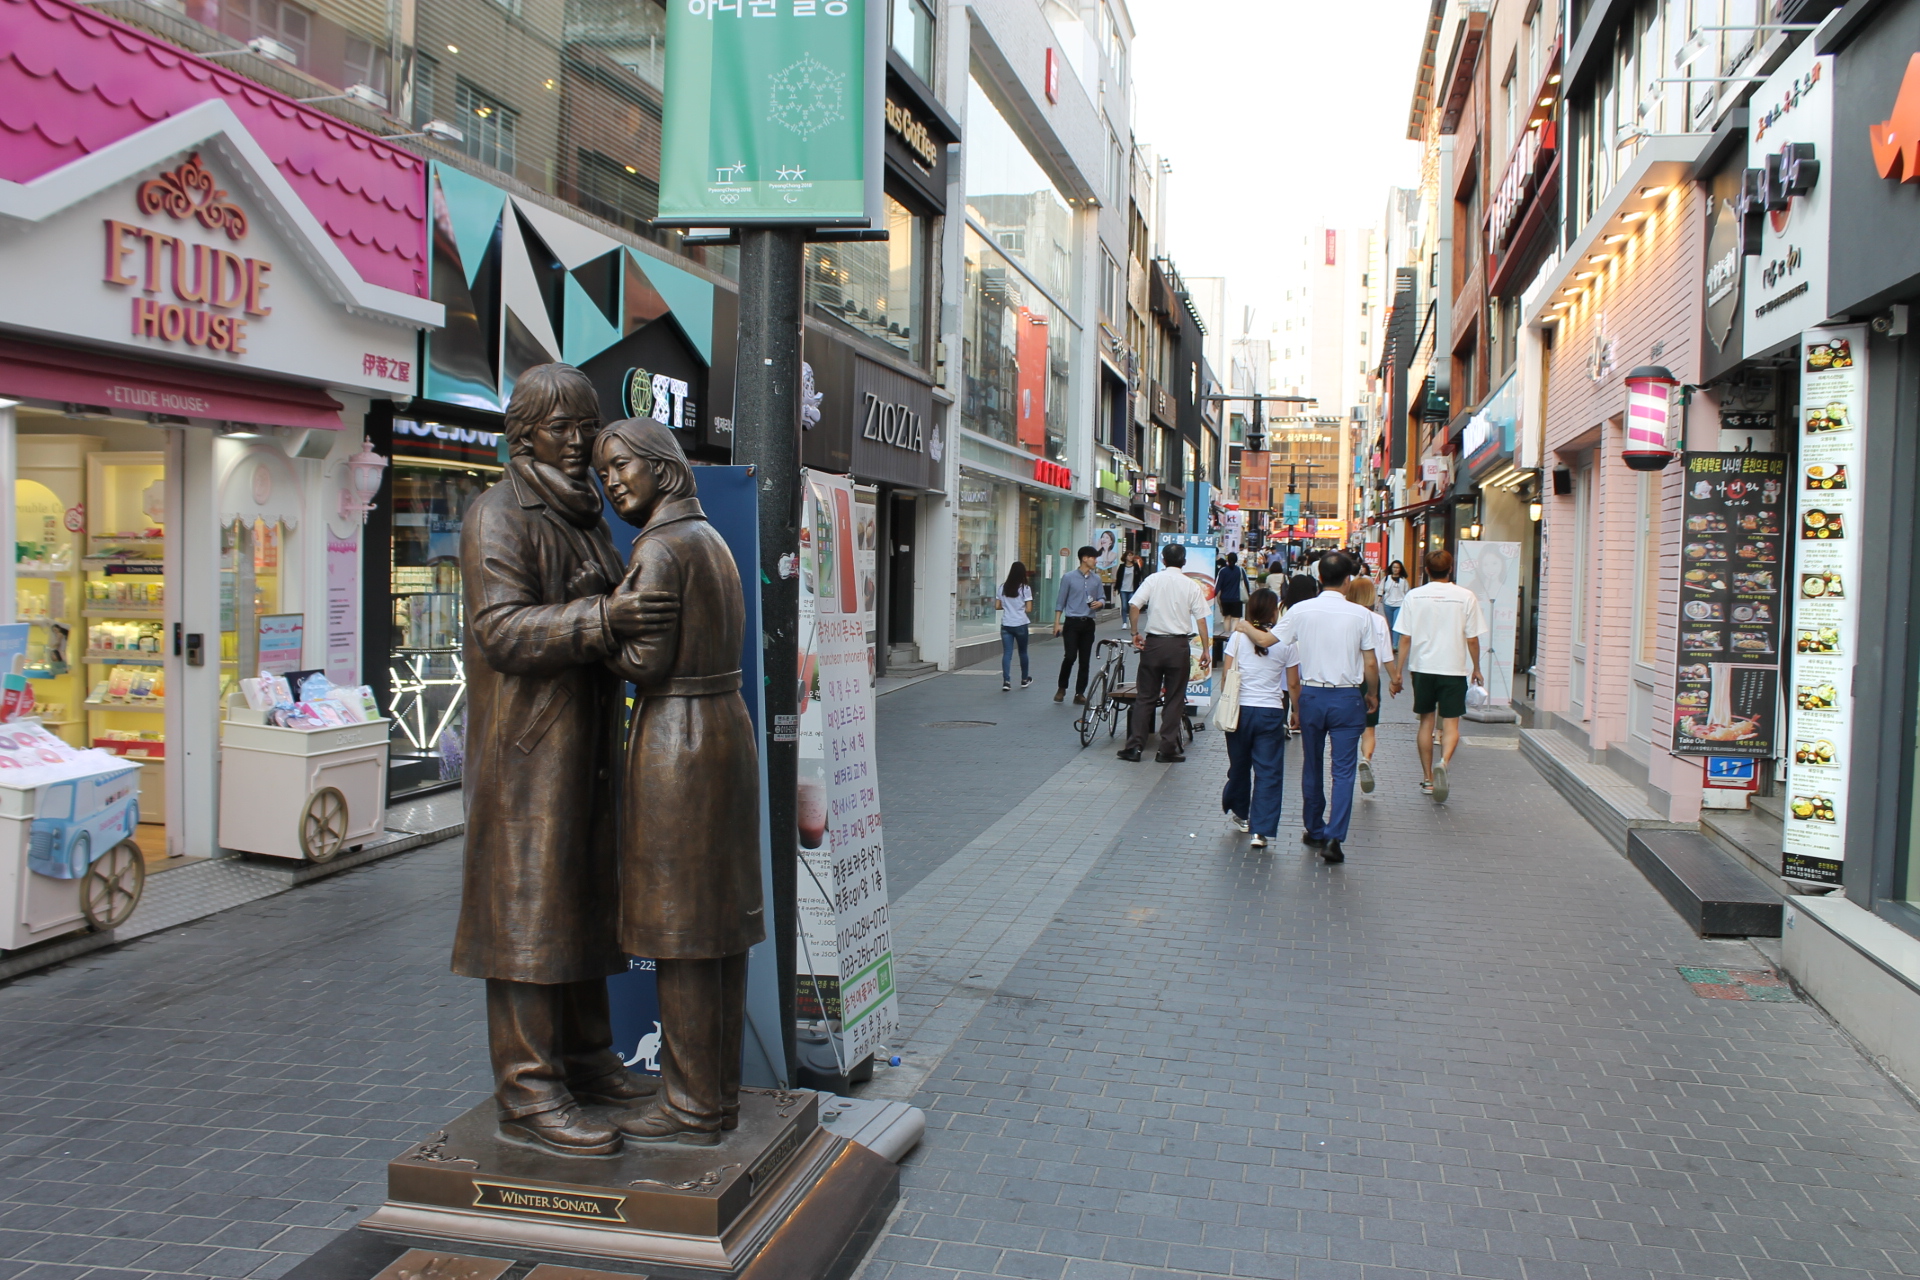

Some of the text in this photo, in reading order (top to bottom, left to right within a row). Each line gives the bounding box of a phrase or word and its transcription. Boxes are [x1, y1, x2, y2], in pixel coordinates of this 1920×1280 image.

[902, 108, 937, 168] Coffee
[103, 218, 272, 317] ETUDE
[131, 297, 248, 355] HOUSE
[361, 352, 411, 383] 伊蒂之屋
[113, 386, 204, 412] ETUDE HOUSE
[863, 391, 924, 454] ZIOZIA
[1227, 515, 1237, 524] kt
[817, 619, 864, 644] 춘천아이폰수리
[819, 651, 842, 667] chuncheon
[828, 677, 860, 702] 액정수리
[827, 704, 866, 731] 메인보드수리
[832, 731, 866, 761] 침수세척
[1679, 737, 1694, 745] Take
[833, 761, 868, 786] 배터리교체
[1719, 761, 1742, 776] 17
[831, 787, 875, 820] 악세사리 판매
[829, 824, 849, 854] 중고폰
[833, 842, 882, 887] 명동브라운상가
[835, 867, 883, 914] 명동cgv앞 1층
[836, 903, 890, 955] 010-4284-0721
[840, 929, 890, 981] 033-256-0721
[853, 1004, 888, 1043] 브라운상가
[499, 1189, 602, 1214] WINTER SONATA
